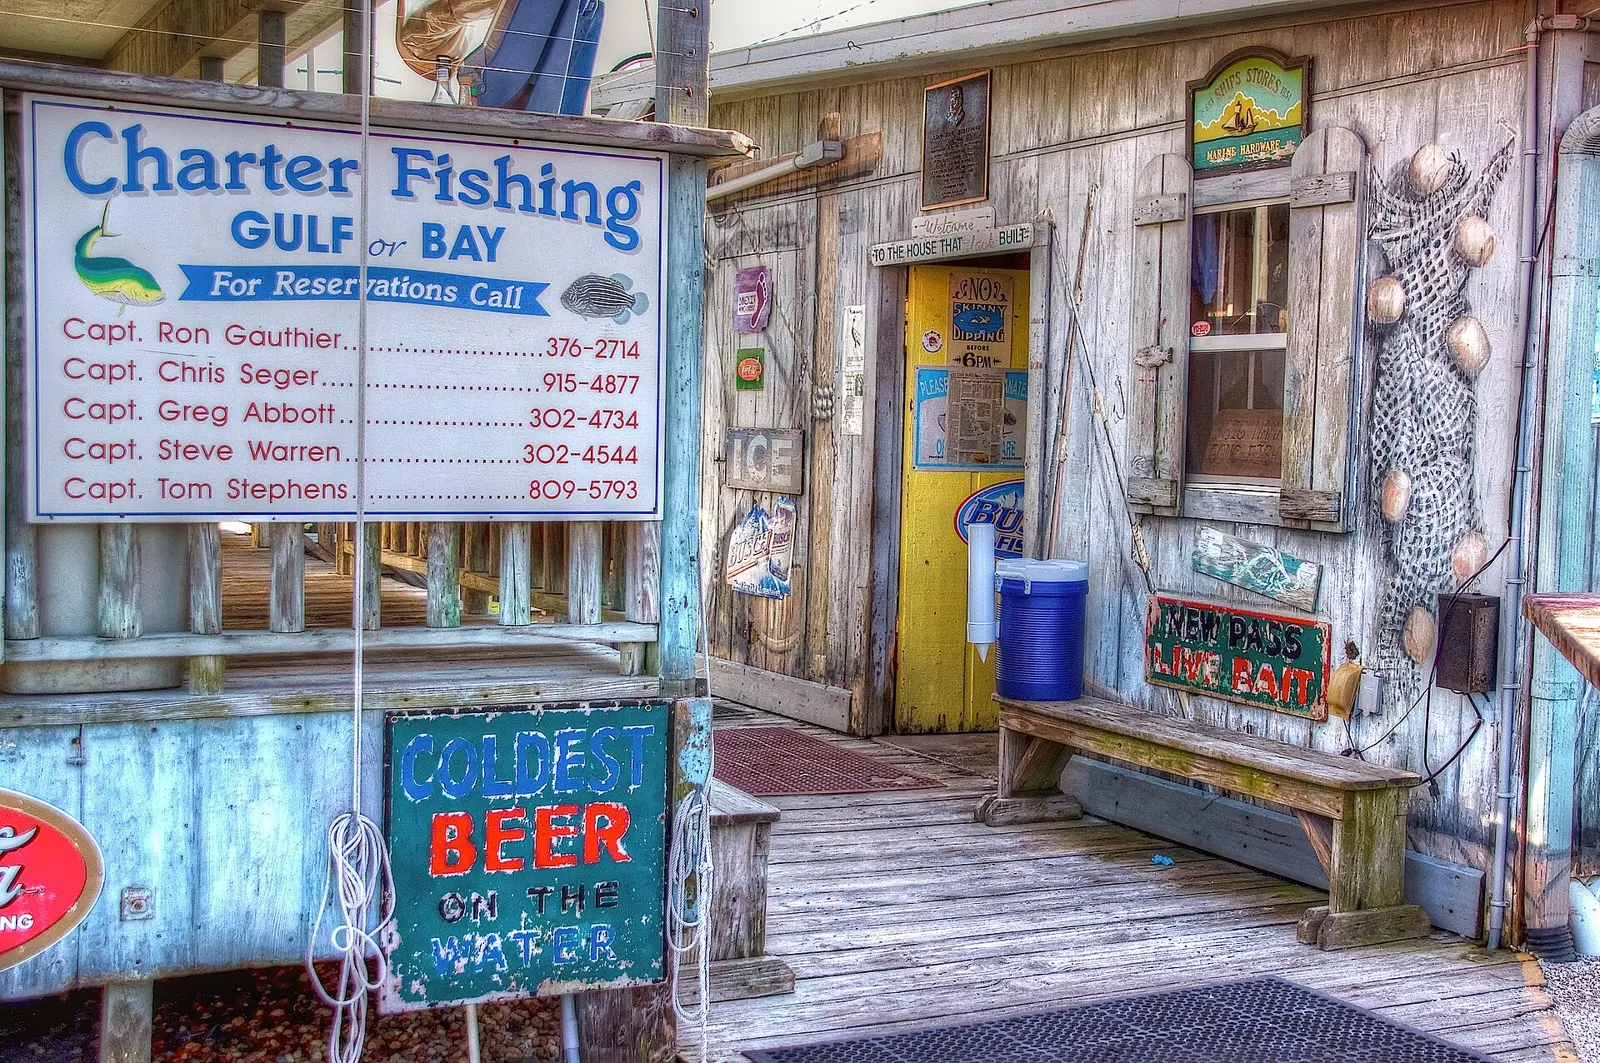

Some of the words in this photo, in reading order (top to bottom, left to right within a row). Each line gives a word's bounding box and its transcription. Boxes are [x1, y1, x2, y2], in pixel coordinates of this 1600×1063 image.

[1214, 71, 1241, 100] SHIPS
[1246, 67, 1281, 94] STORES
[1206, 146, 1237, 161] MARINE
[1240, 139, 1281, 155] HARDWARE
[64, 120, 361, 198] Charter
[391, 147, 643, 253] Fishing
[231, 210, 354, 253] GULF
[368, 238, 407, 257] or
[422, 222, 507, 263] BAY
[923, 216, 974, 234] Welcome
[874, 248, 885, 262] TO
[888, 245, 904, 260] THE
[906, 241, 937, 258] HOUSE
[940, 237, 963, 252] THAT
[999, 227, 1026, 245] BUILT
[210, 271, 262, 296] For
[273, 271, 458, 303] Reservations
[471, 282, 525, 310] Call
[969, 277, 992, 301] NO
[954, 302, 1007, 318] SKINNY
[63, 317, 143, 344] Capt.
[158, 320, 211, 343] Ron
[225, 323, 341, 350] Gauthier
[546, 337, 640, 360] 376-2714
[953, 326, 1004, 342] DIPPING
[63, 358, 143, 385] Capt.
[158, 360, 226, 384] Chris
[241, 364, 319, 390] Seger
[543, 373, 640, 394] 915-4877
[962, 352, 992, 368] 6PM
[63, 398, 143, 424] Capt.
[158, 400, 229, 427] Greg
[243, 402, 335, 425] Abbott
[530, 408, 640, 430] 302-4734
[63, 438, 143, 464] Capt.
[158, 439, 234, 462] Steve
[248, 441, 341, 464] Warren
[523, 443, 640, 466] 302-4544
[734, 434, 793, 486] ICE
[63, 477, 143, 503] Capt.
[158, 479, 212, 501] Tom
[226, 480, 348, 502] Stephens
[528, 479, 639, 501] 809-5793
[966, 498, 1024, 533] BU
[1165, 603, 1220, 644] NEW
[1228, 615, 1303, 662] PASS
[1153, 643, 1221, 686] LIVE
[1232, 656, 1315, 706] BAIT
[402, 725, 655, 804] COLDEST
[429, 802, 633, 878] BEER
[438, 890, 499, 924] ON
[526, 881, 620, 918] THE
[431, 924, 617, 976] WATER
